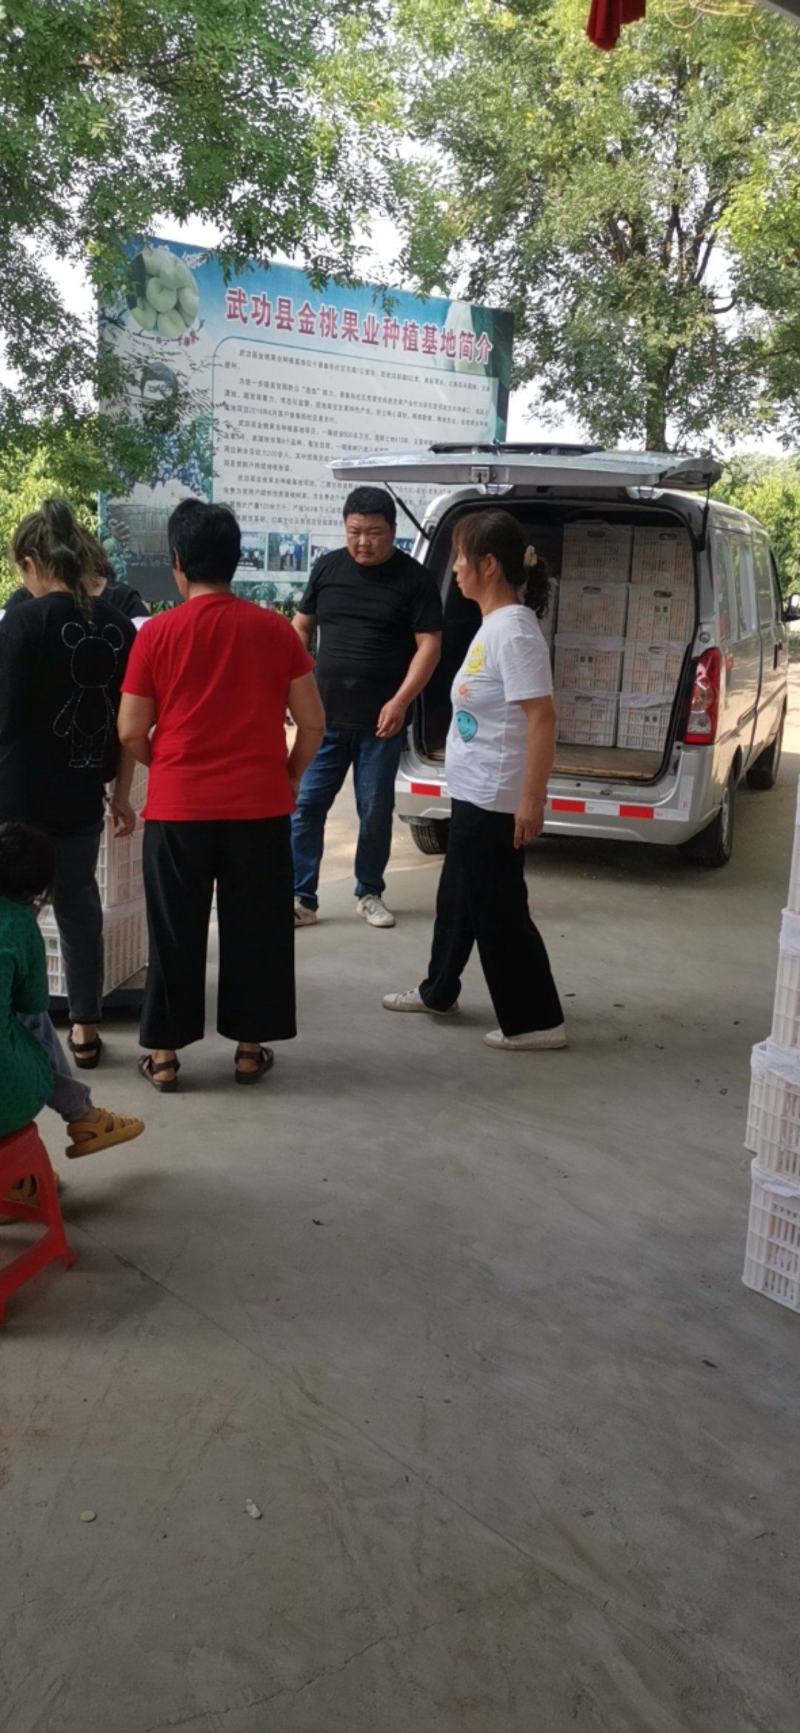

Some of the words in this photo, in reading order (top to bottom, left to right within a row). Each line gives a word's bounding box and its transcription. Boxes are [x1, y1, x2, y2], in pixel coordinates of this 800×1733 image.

[226, 288, 492, 362] 武功县金桃果业种植基地简介
